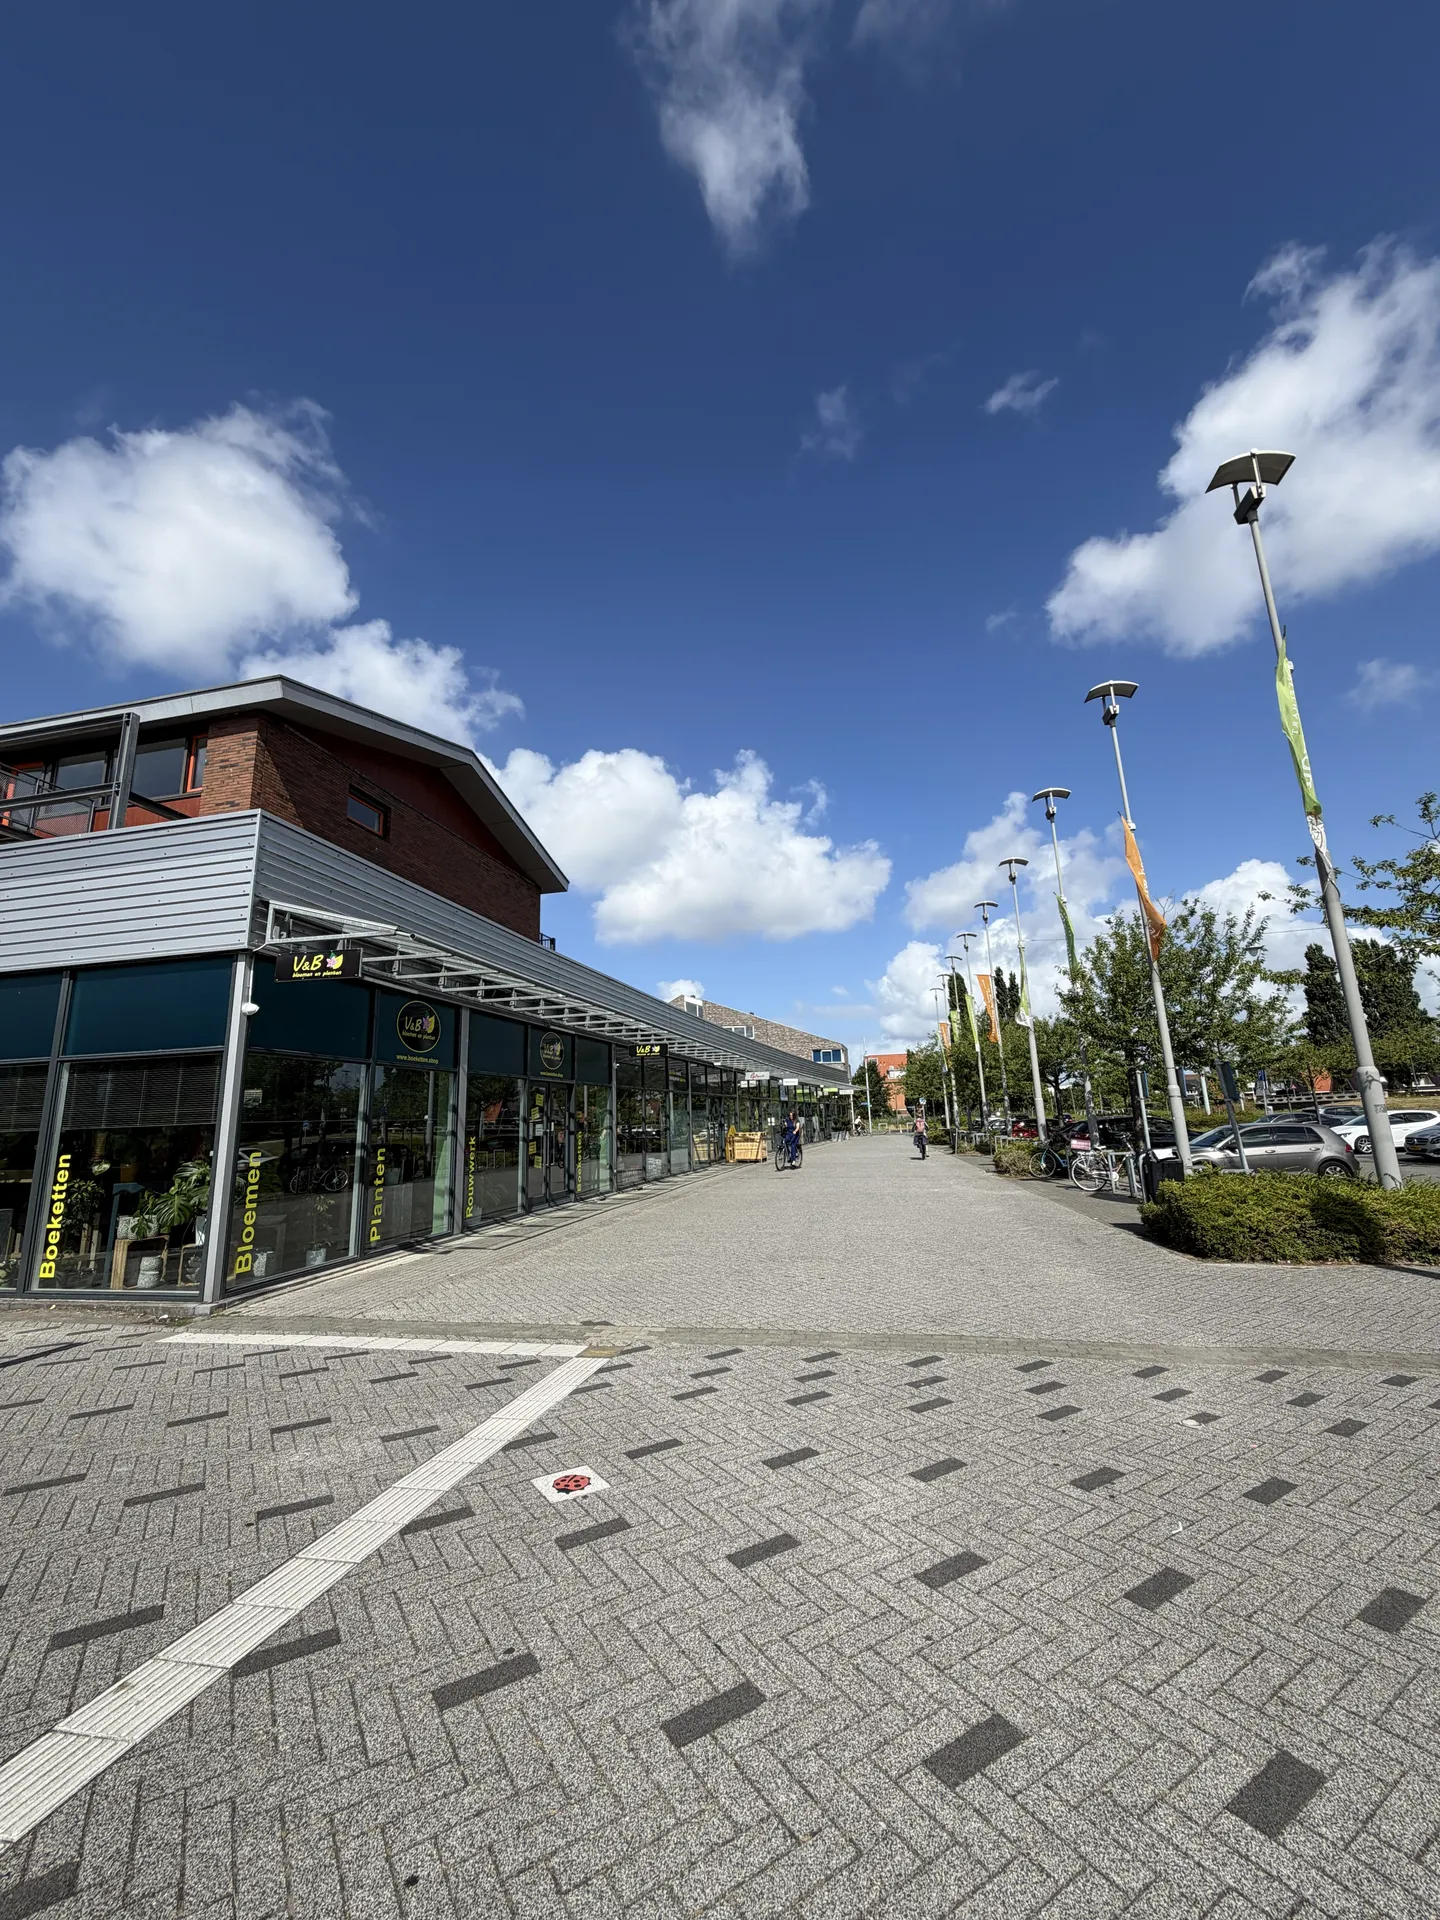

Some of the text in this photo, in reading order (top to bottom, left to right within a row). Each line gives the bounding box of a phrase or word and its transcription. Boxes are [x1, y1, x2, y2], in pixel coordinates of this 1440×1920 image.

[293, 954, 324, 971] V&B
[405, 1016, 422, 1031] V&B
[636, 1045, 651, 1053] V&B
[39, 1154, 71, 1278] Boeketten
[235, 1152, 261, 1274] Bloemen
[369, 1148, 386, 1241] Planten
[466, 1136, 476, 1218] Rouwwerk
